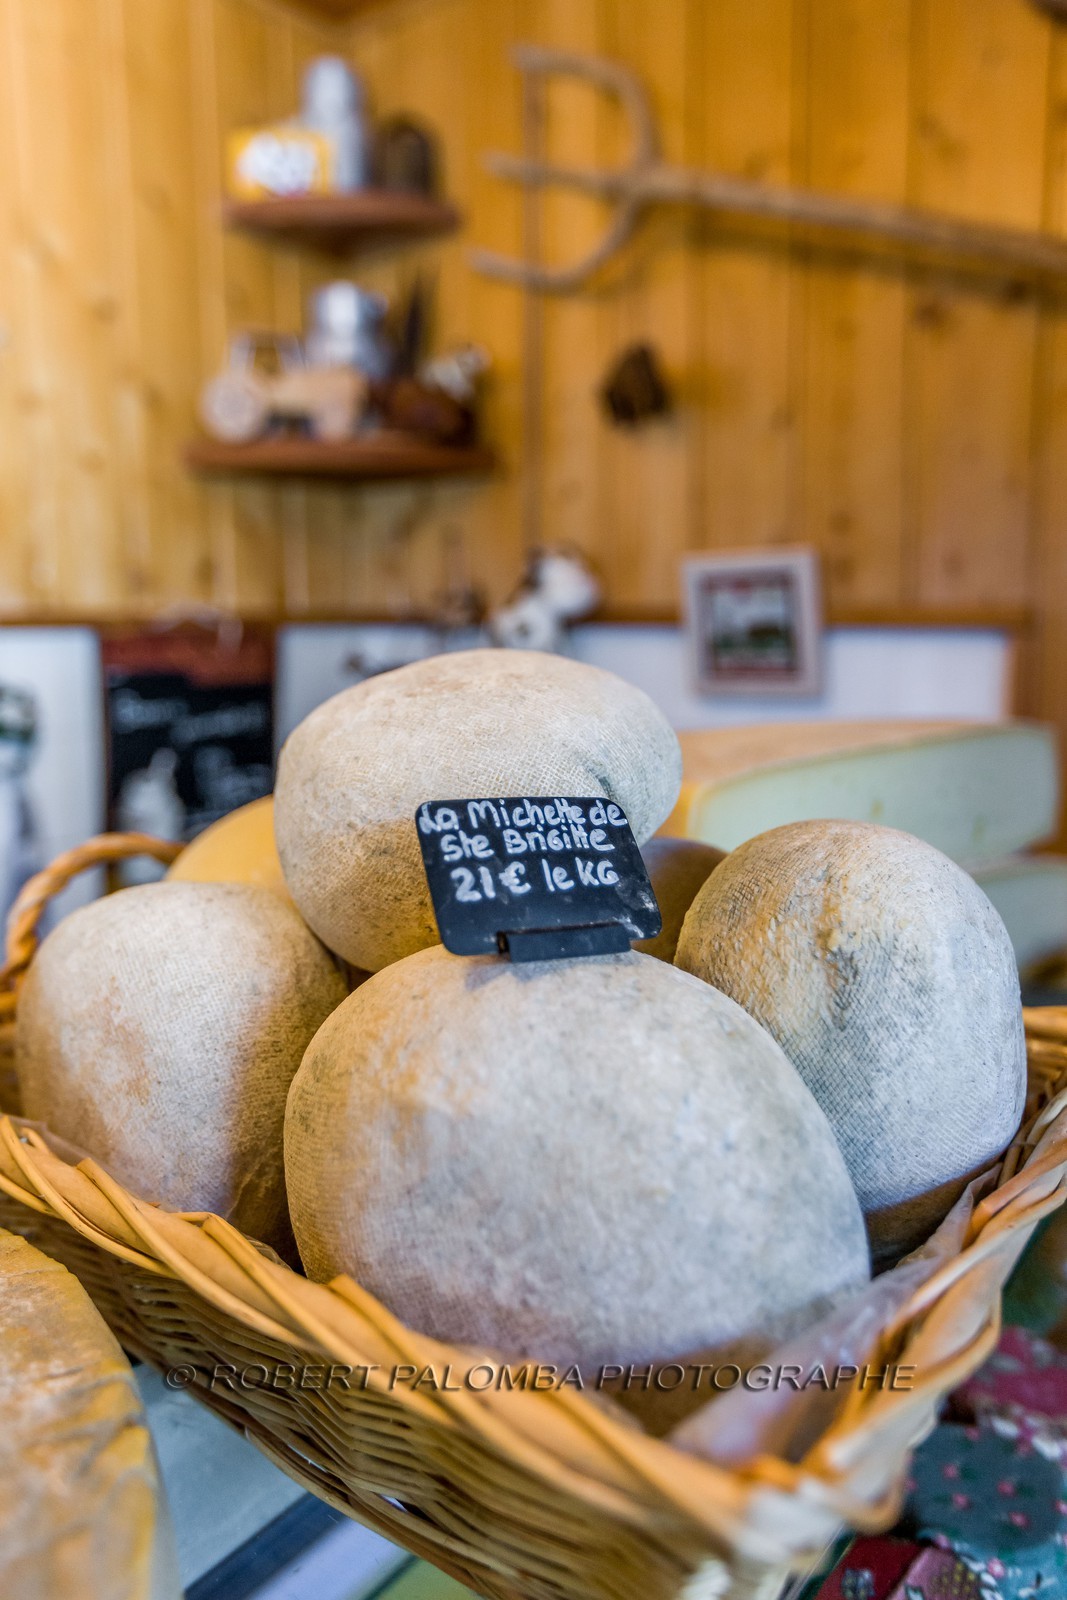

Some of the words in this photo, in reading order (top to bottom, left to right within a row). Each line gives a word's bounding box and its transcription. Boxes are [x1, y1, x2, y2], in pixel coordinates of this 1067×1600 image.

[419, 801, 460, 834] La
[589, 799, 628, 826] de
[441, 830, 495, 862] Ste
[541, 858, 575, 892] le
